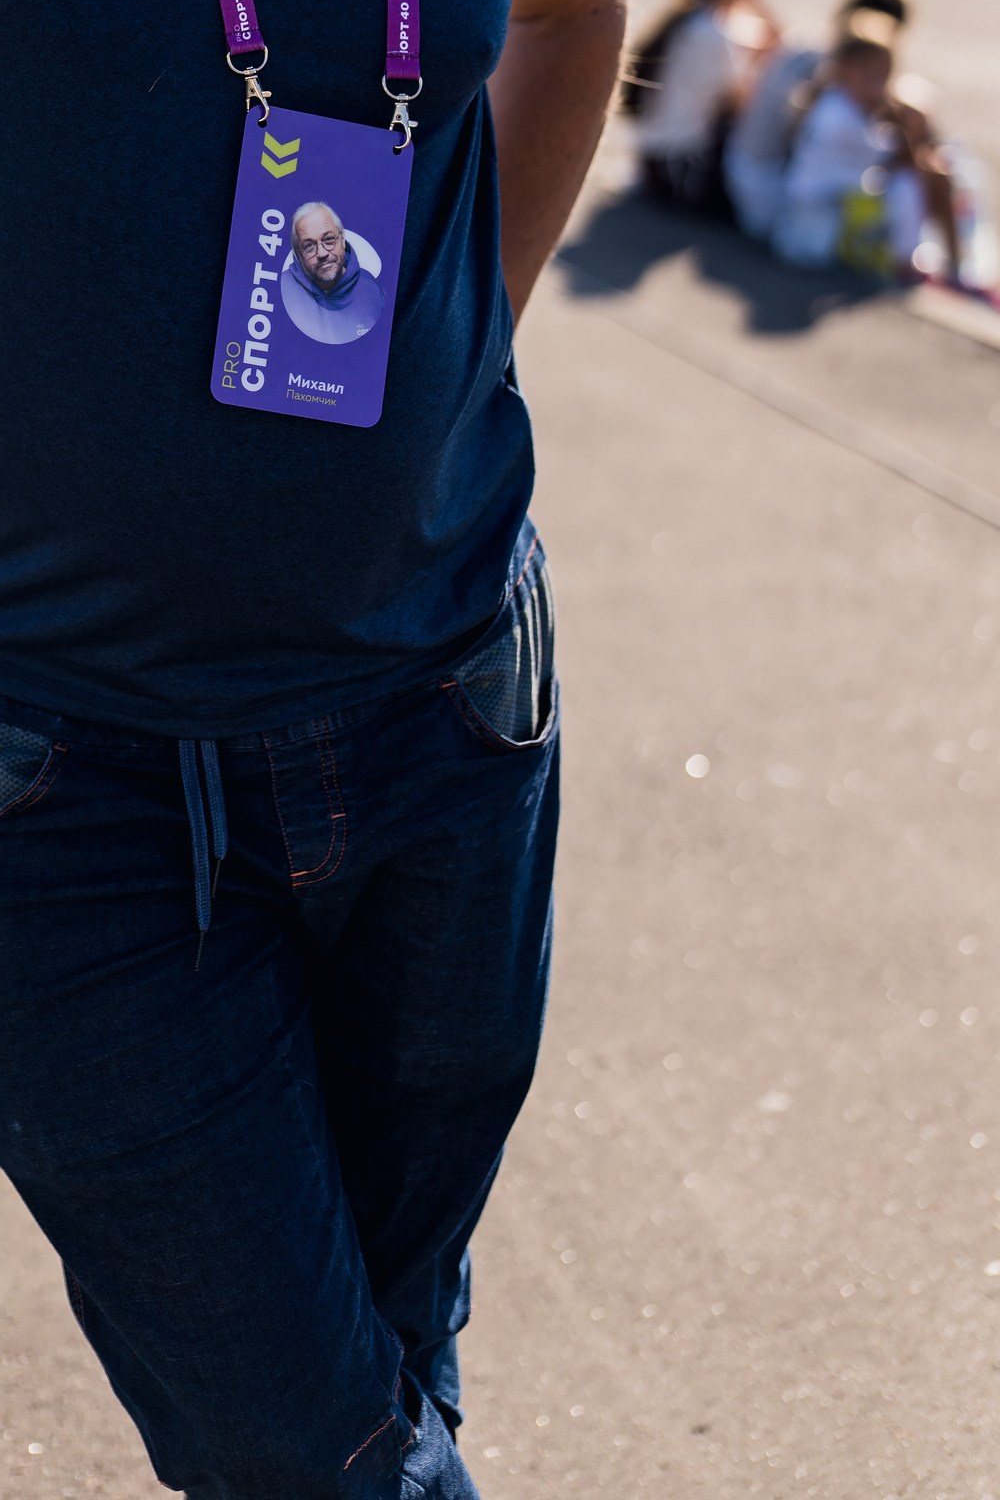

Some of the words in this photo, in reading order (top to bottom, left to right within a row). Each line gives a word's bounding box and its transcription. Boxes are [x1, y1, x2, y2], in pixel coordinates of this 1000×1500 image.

[400, 2, 410, 20] 40
[258, 208, 286, 257] 40
[241, 261, 278, 392] СПОРТ
[222, 341, 241, 389] PRO
[286, 388, 337, 407] Пахомчик
[288, 372, 344, 395] Михаил
